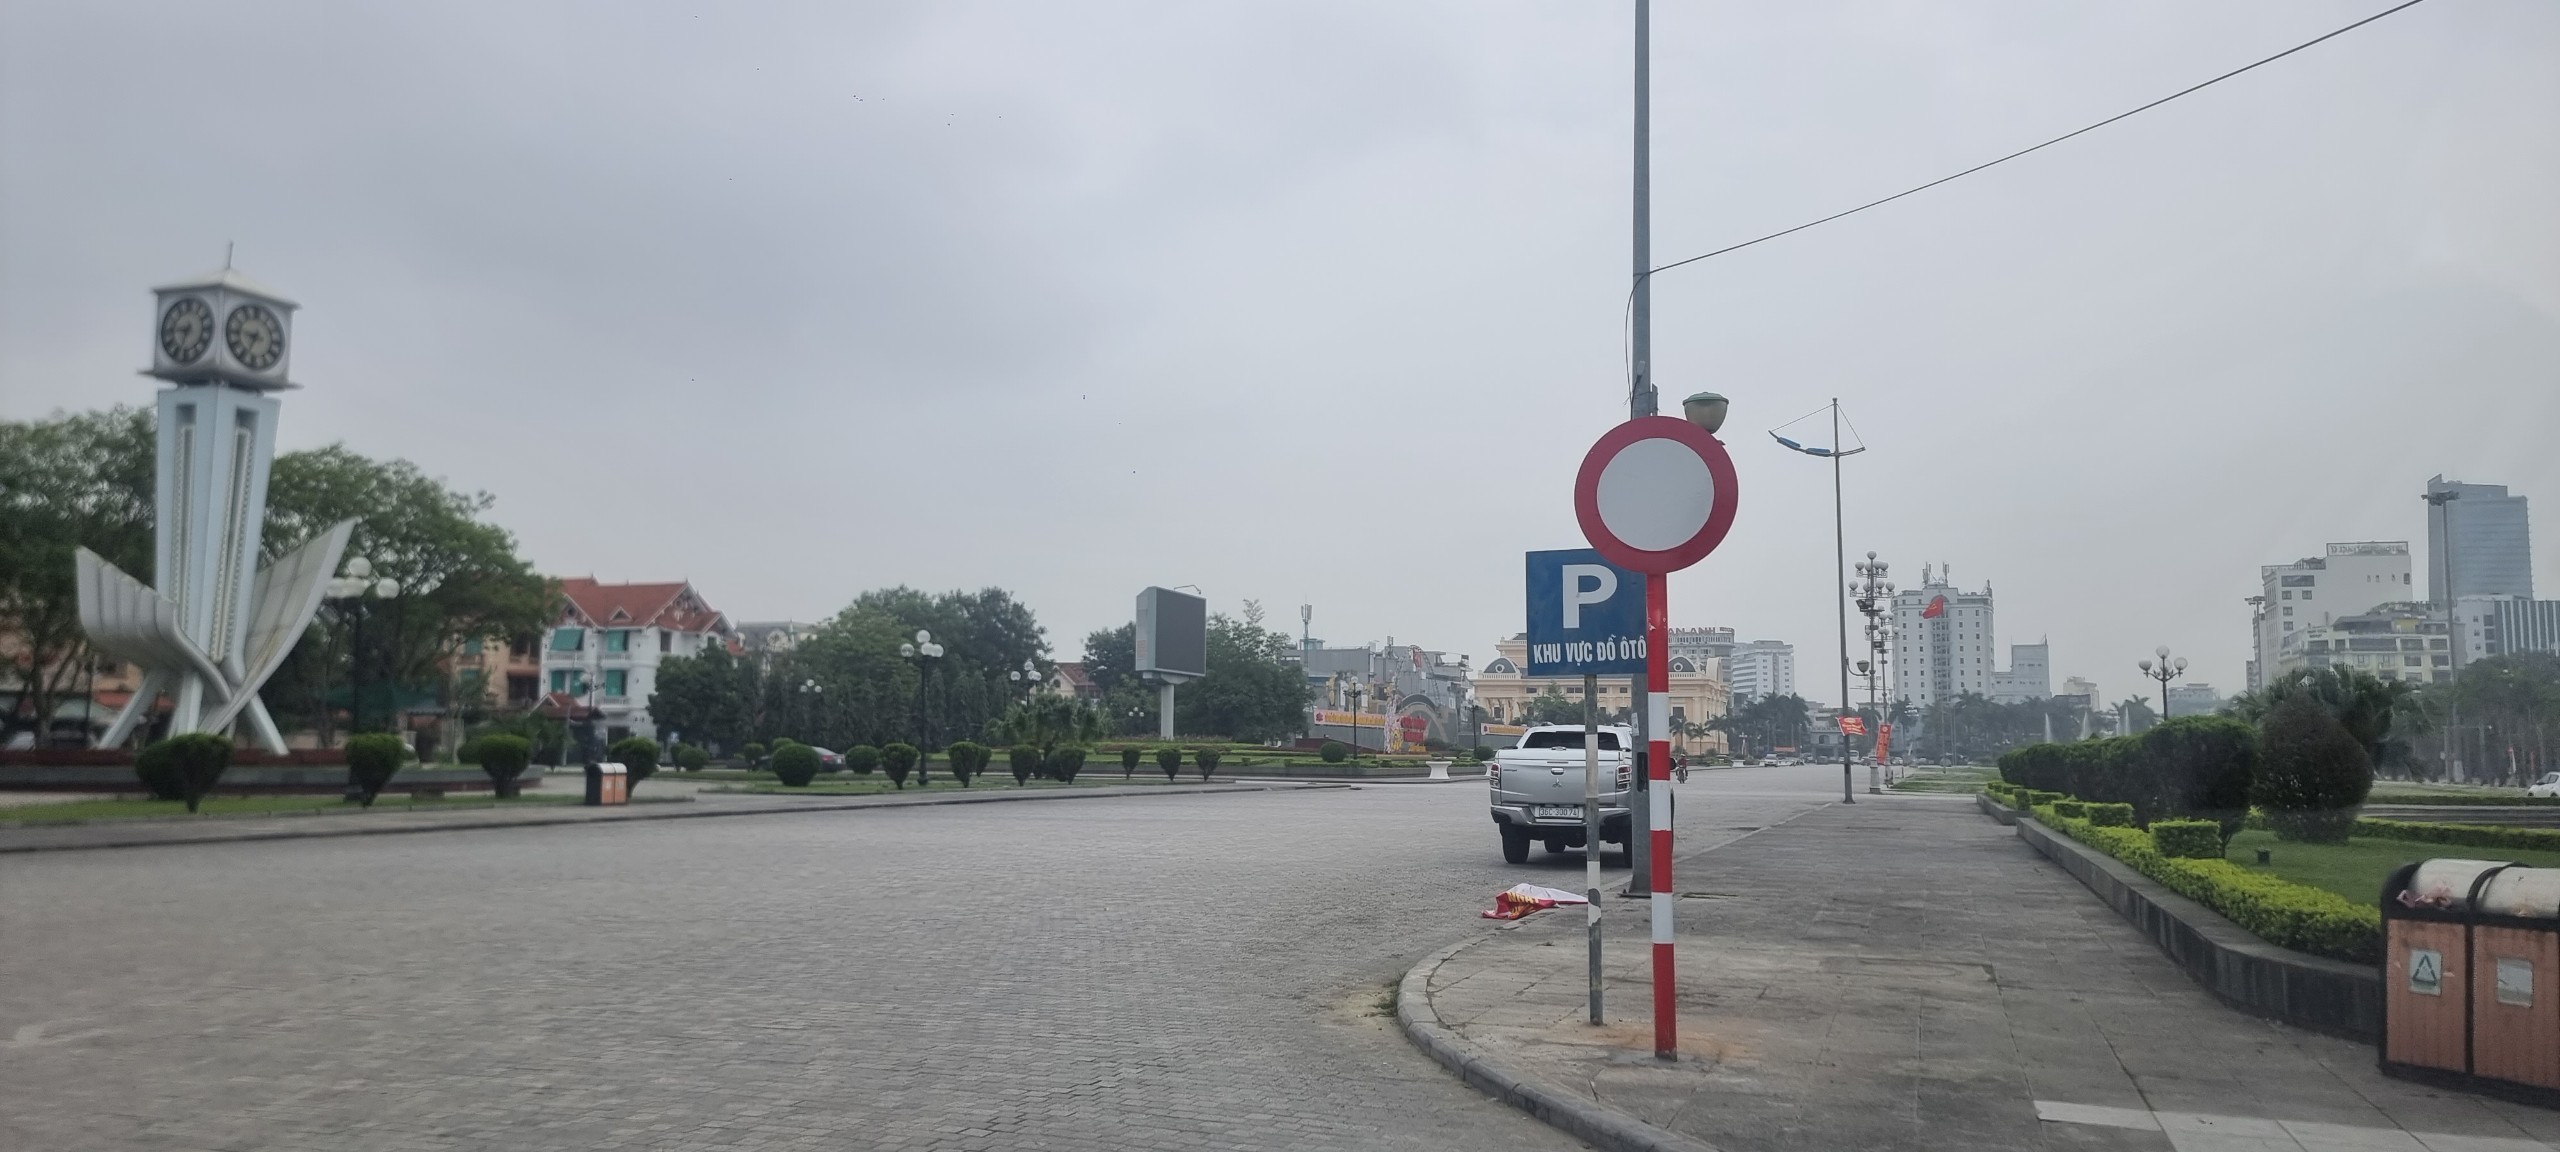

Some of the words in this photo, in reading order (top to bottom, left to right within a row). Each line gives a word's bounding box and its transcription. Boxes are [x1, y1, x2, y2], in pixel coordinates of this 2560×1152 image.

[1562, 564, 1618, 629] P
[1533, 643, 1561, 664] KHU
[1565, 640, 1593, 667] VỰC
[1596, 633, 1617, 662] ĐỖ
[1620, 635, 1647, 660] ÔTÔ
